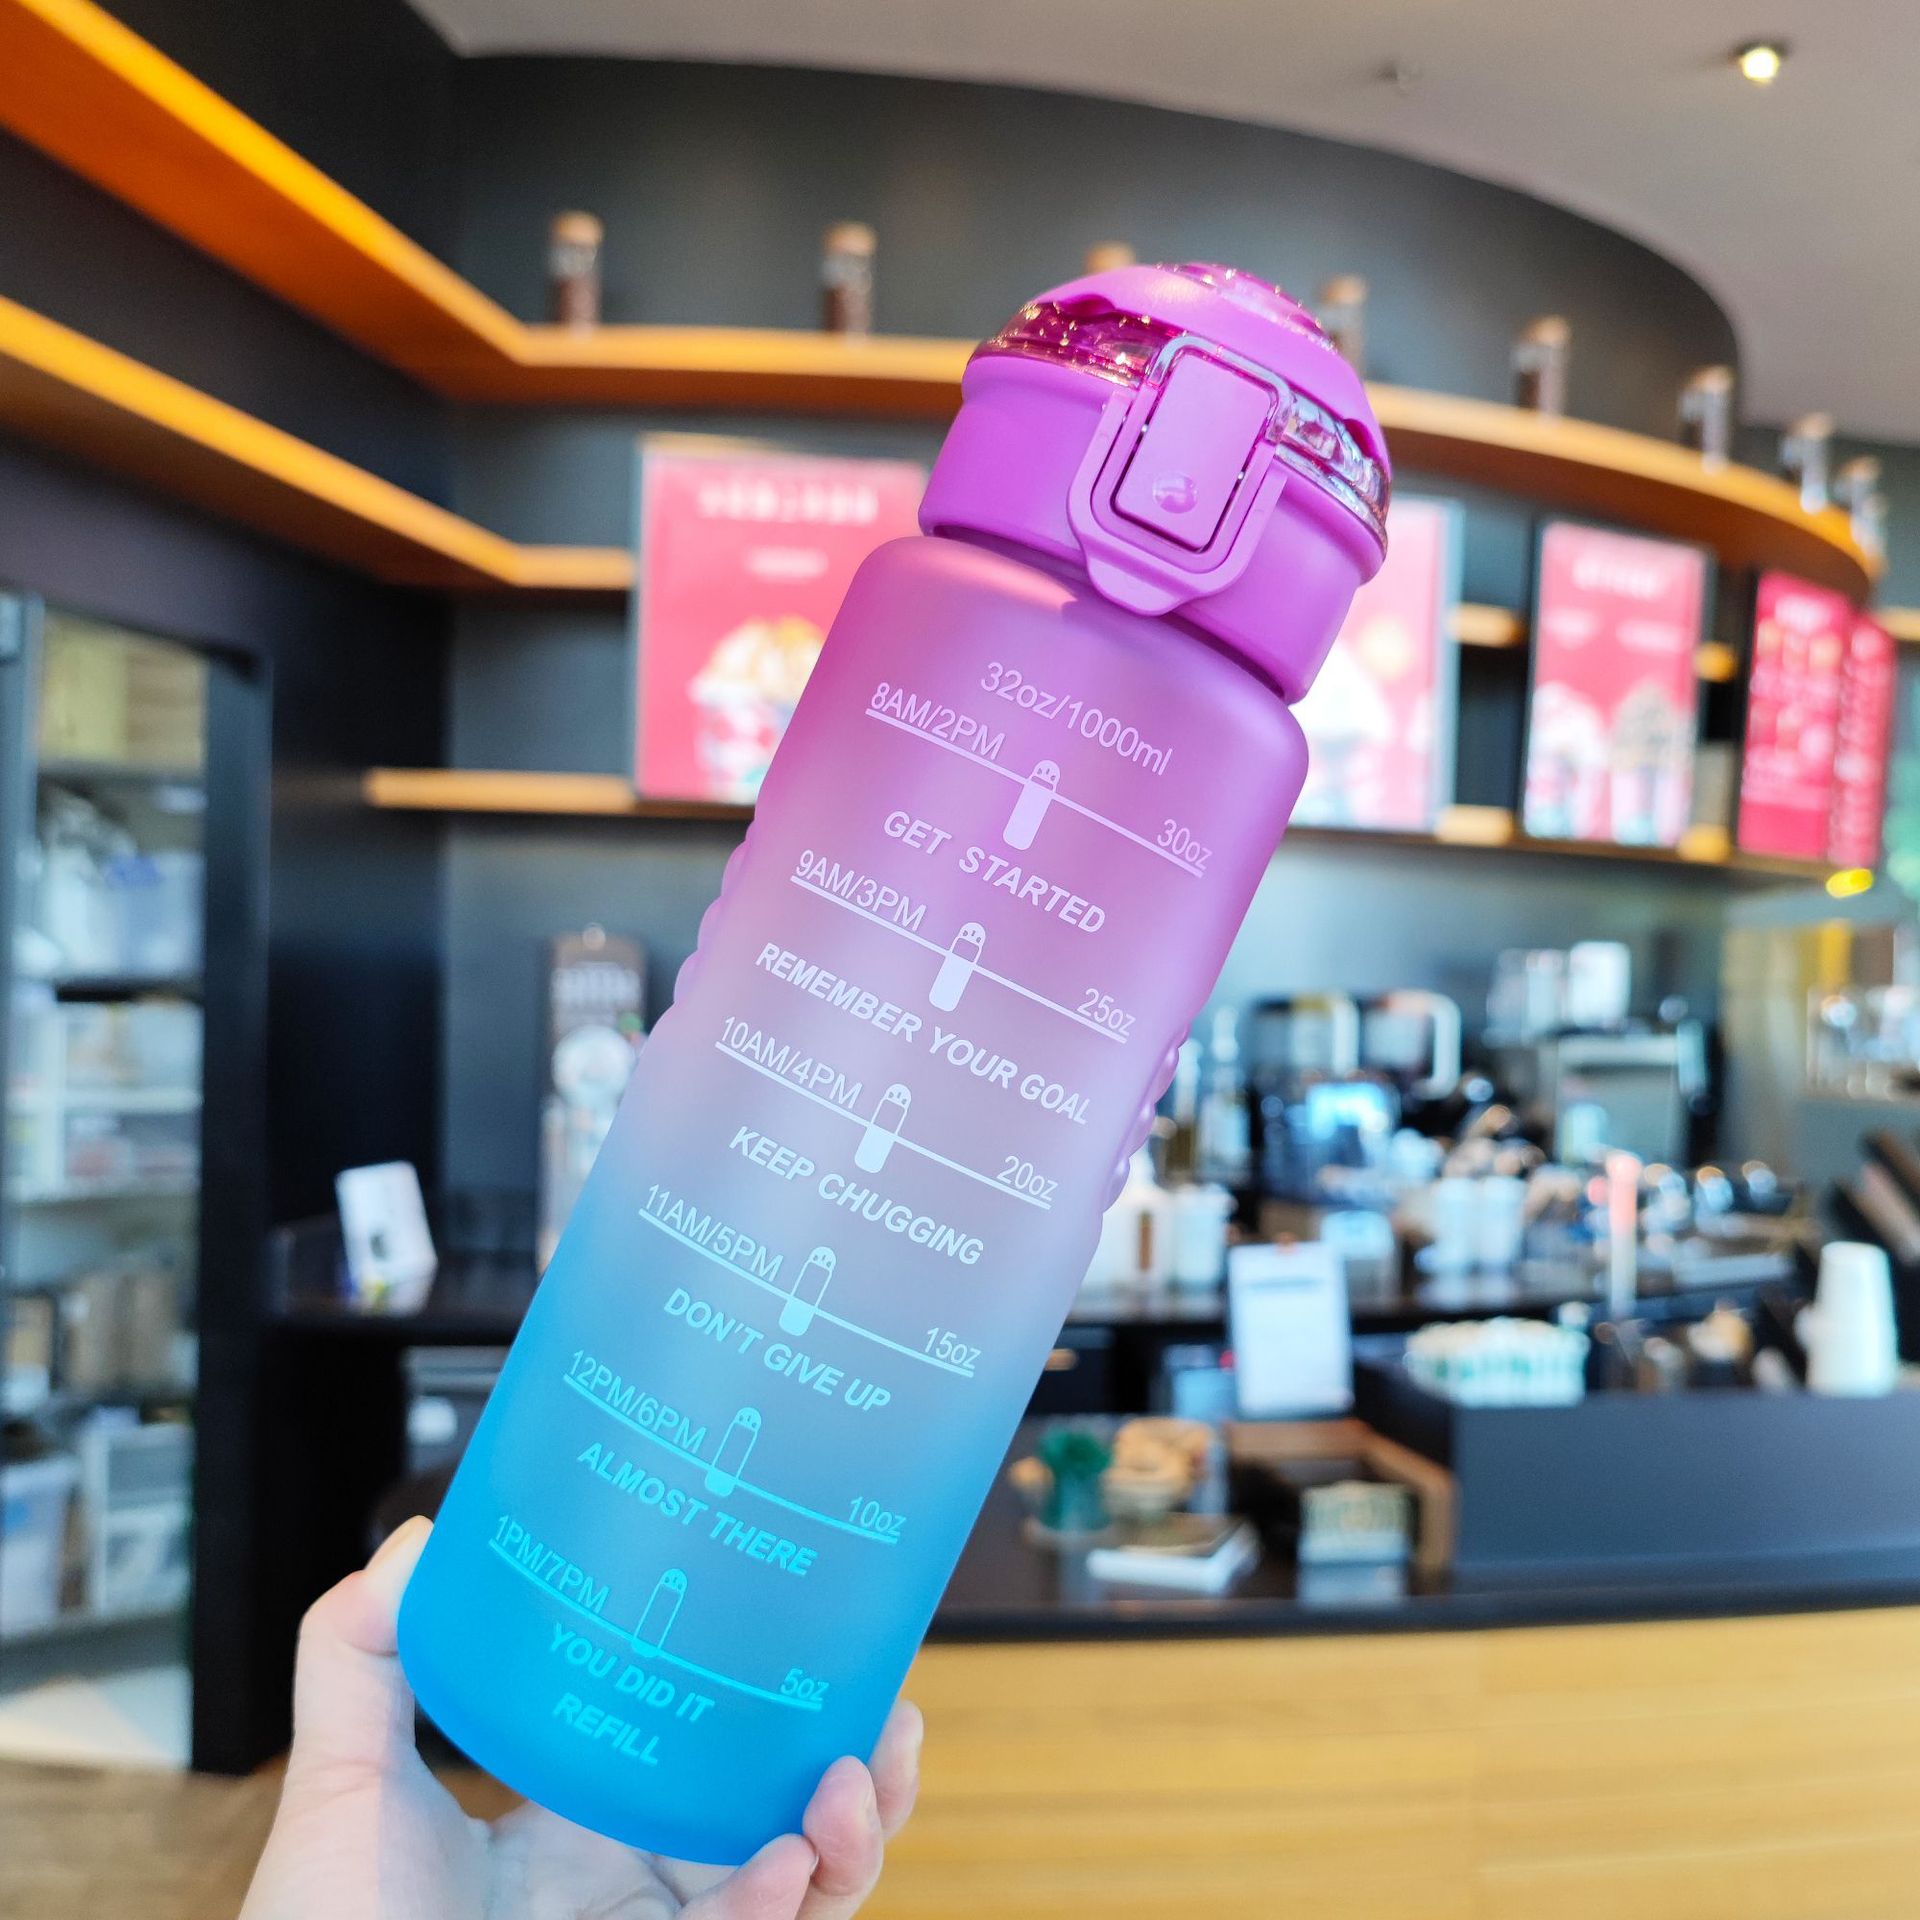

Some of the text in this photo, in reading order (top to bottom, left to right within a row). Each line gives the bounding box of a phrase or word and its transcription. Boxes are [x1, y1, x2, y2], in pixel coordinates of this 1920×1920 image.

[870, 682, 1006, 761] 8AM/2PM
[980, 661, 1174, 776] 32oz/1000ml
[796, 849, 927, 932] 9AM/3PM
[884, 811, 1105, 933] GET STARTED
[1157, 819, 1213, 870] 30oz
[755, 942, 1090, 1125] REMEMBER YOUR GOAL
[1077, 988, 1136, 1036] 25oz
[721, 1016, 863, 1109] 10AM/4PM
[729, 1126, 985, 1265] KEEP CHUGGING
[997, 1155, 1059, 1201] 20oz
[645, 1183, 784, 1282] 11AM/5PM
[663, 1287, 891, 1413] DON'T GIVE UP
[924, 1326, 981, 1370] 15oz
[569, 1349, 708, 1455] 12PM/6PM
[577, 1442, 818, 1577] ALMOST THERE
[849, 1495, 906, 1538] 10oz
[497, 1514, 610, 1612] 1PM/7PM
[549, 1622, 715, 1723] YOU DID IT
[781, 1668, 830, 1701] 5oz
[553, 1691, 659, 1766] REFILL
